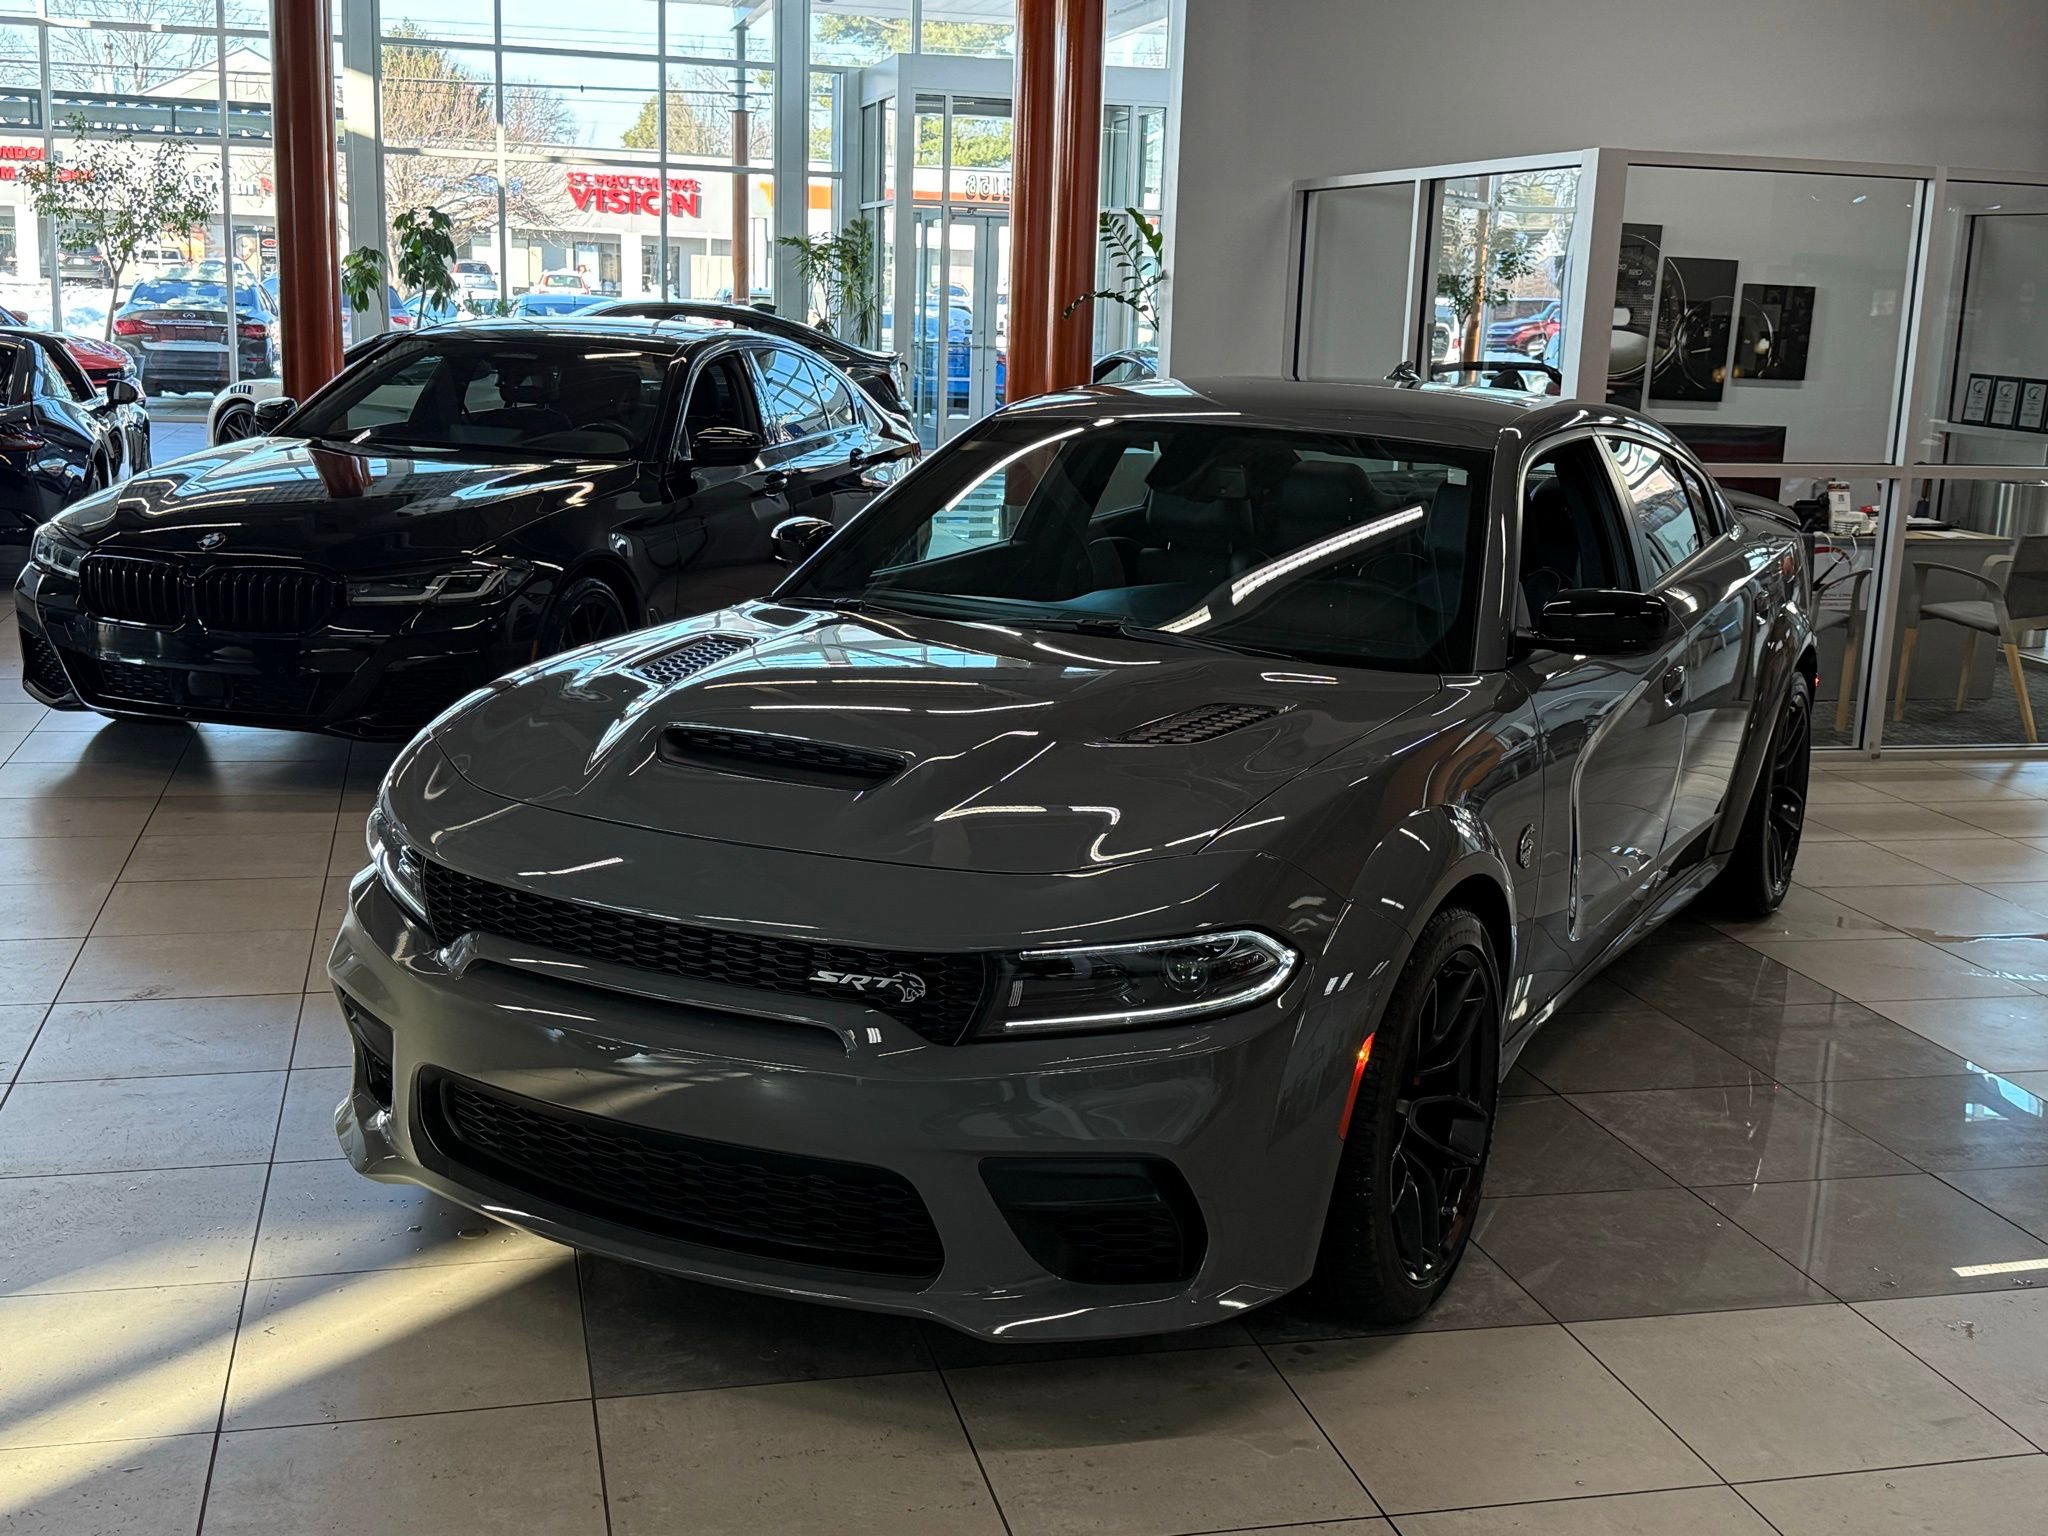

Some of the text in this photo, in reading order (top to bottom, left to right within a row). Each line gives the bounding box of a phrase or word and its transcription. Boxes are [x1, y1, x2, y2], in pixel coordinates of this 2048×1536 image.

[567, 186, 701, 218] VISION
[1637, 279, 1652, 287] 140
[808, 970, 902, 991] SRT
